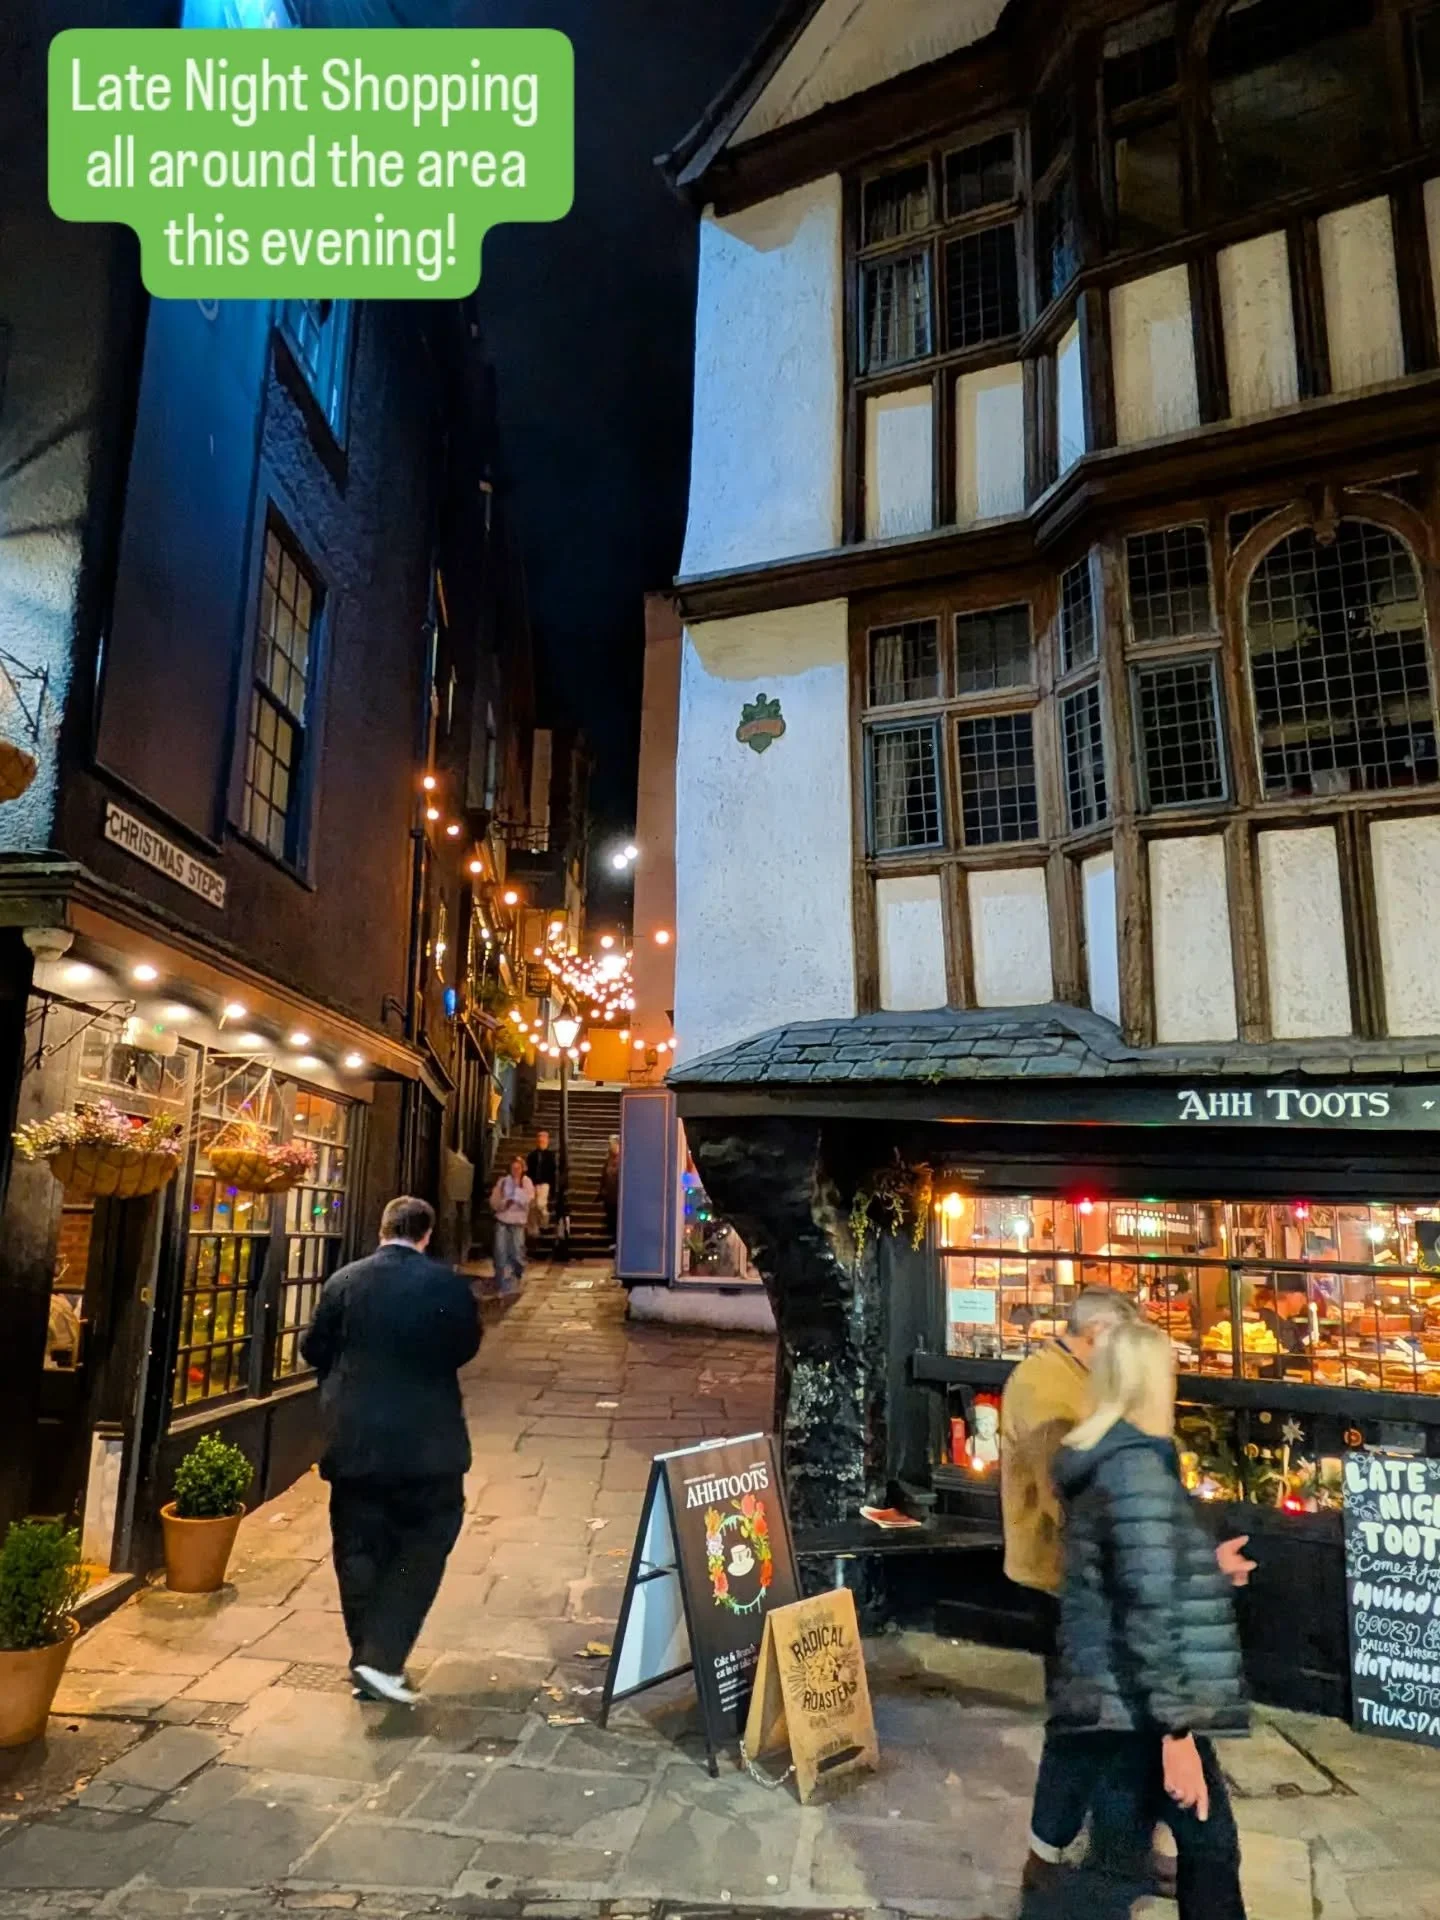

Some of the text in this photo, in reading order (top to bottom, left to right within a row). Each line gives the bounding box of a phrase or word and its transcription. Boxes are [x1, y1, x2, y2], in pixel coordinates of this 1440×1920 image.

[110, 810, 223, 903] CHRISTMAS STEPS
[1177, 1089, 1390, 1120] AHH TOOTS
[686, 1468, 769, 1509] AHHTOOTS
[1345, 1460, 1427, 1493] LATE
[1358, 1521, 1440, 1561] TOOT
[1357, 1554, 1404, 1574] Come
[791, 1625, 845, 1663] RADICAL
[1405, 1645, 1440, 1661] WHISKE
